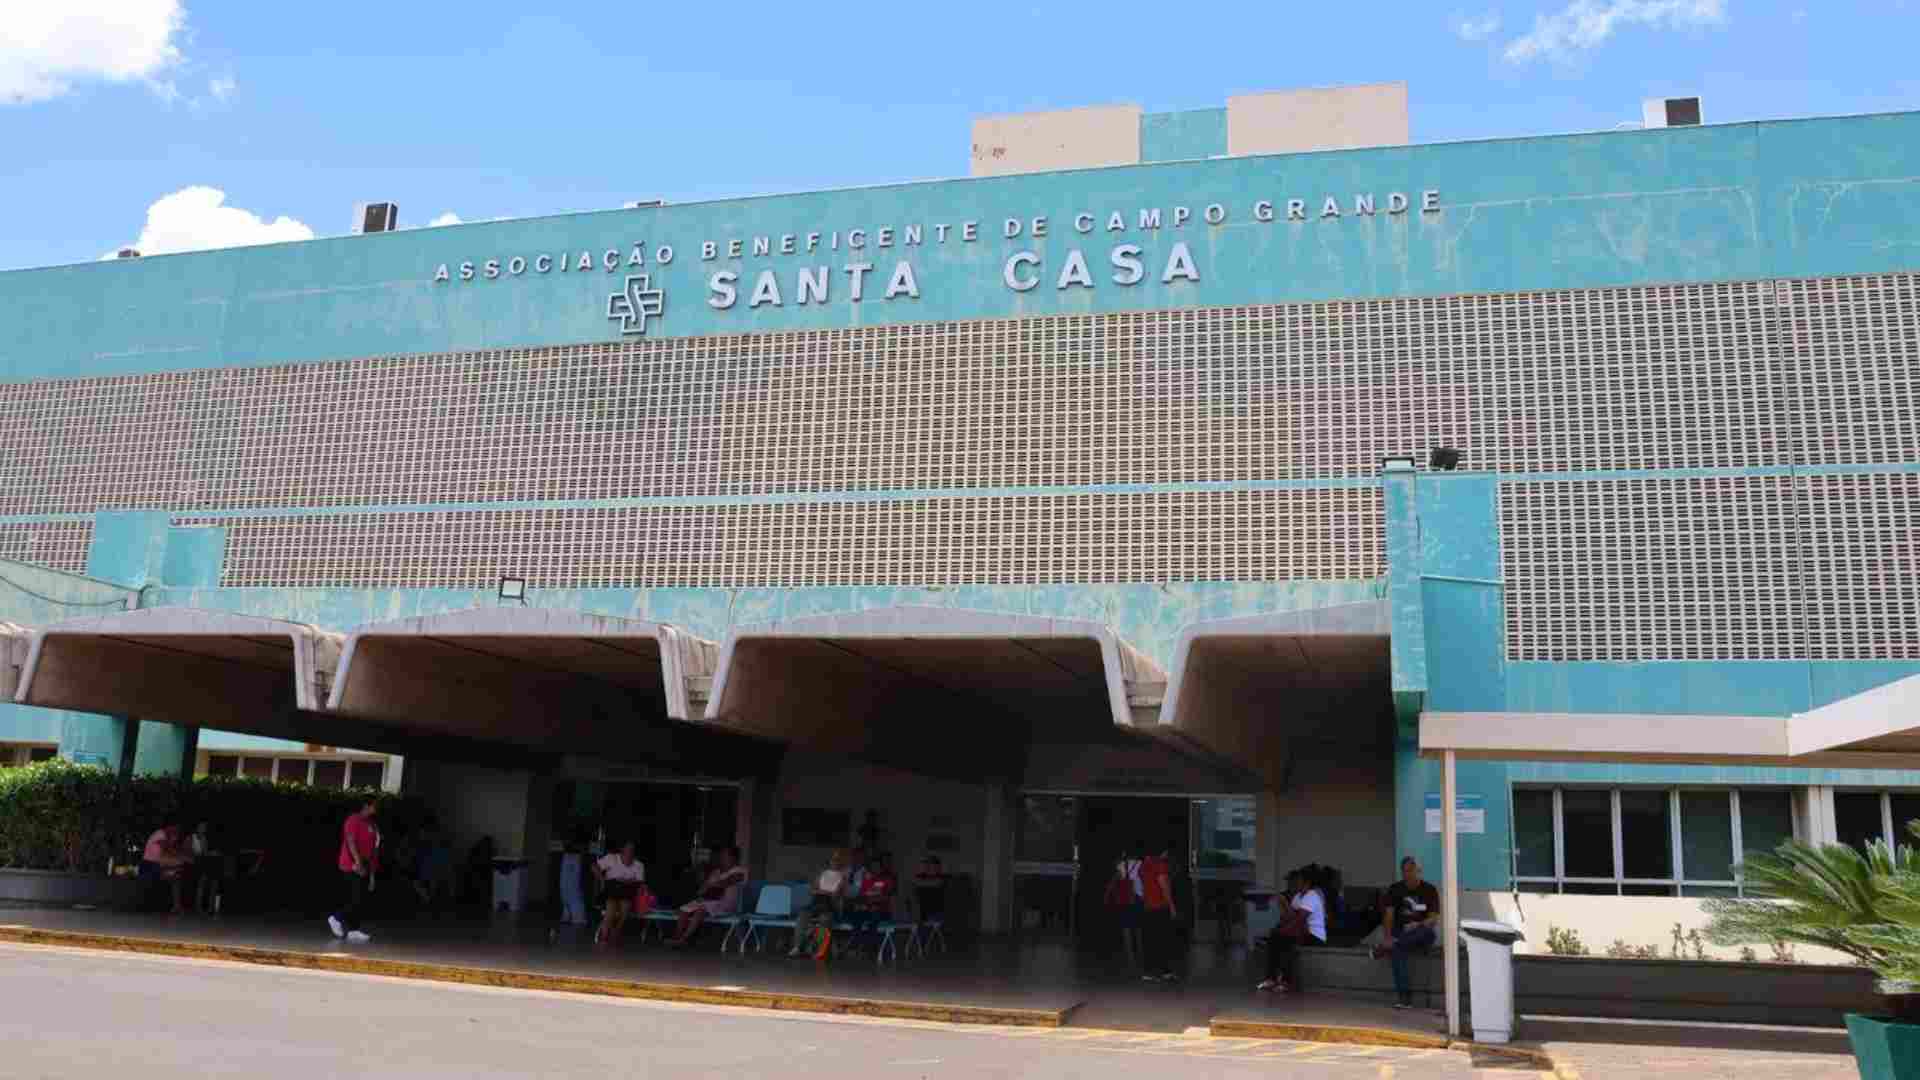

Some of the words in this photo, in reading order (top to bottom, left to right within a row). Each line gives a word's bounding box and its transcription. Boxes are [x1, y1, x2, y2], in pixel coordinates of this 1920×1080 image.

[434, 241, 674, 281] ASSOCIAÇÃO
[701, 221, 978, 260] BENEFICENTE
[1004, 216, 1048, 238] DE
[1074, 204, 1226, 233] CAMPO
[1253, 189, 1441, 222] GRANDE
[709, 262, 921, 309] SANTA
[1003, 242, 1200, 291] CASA
